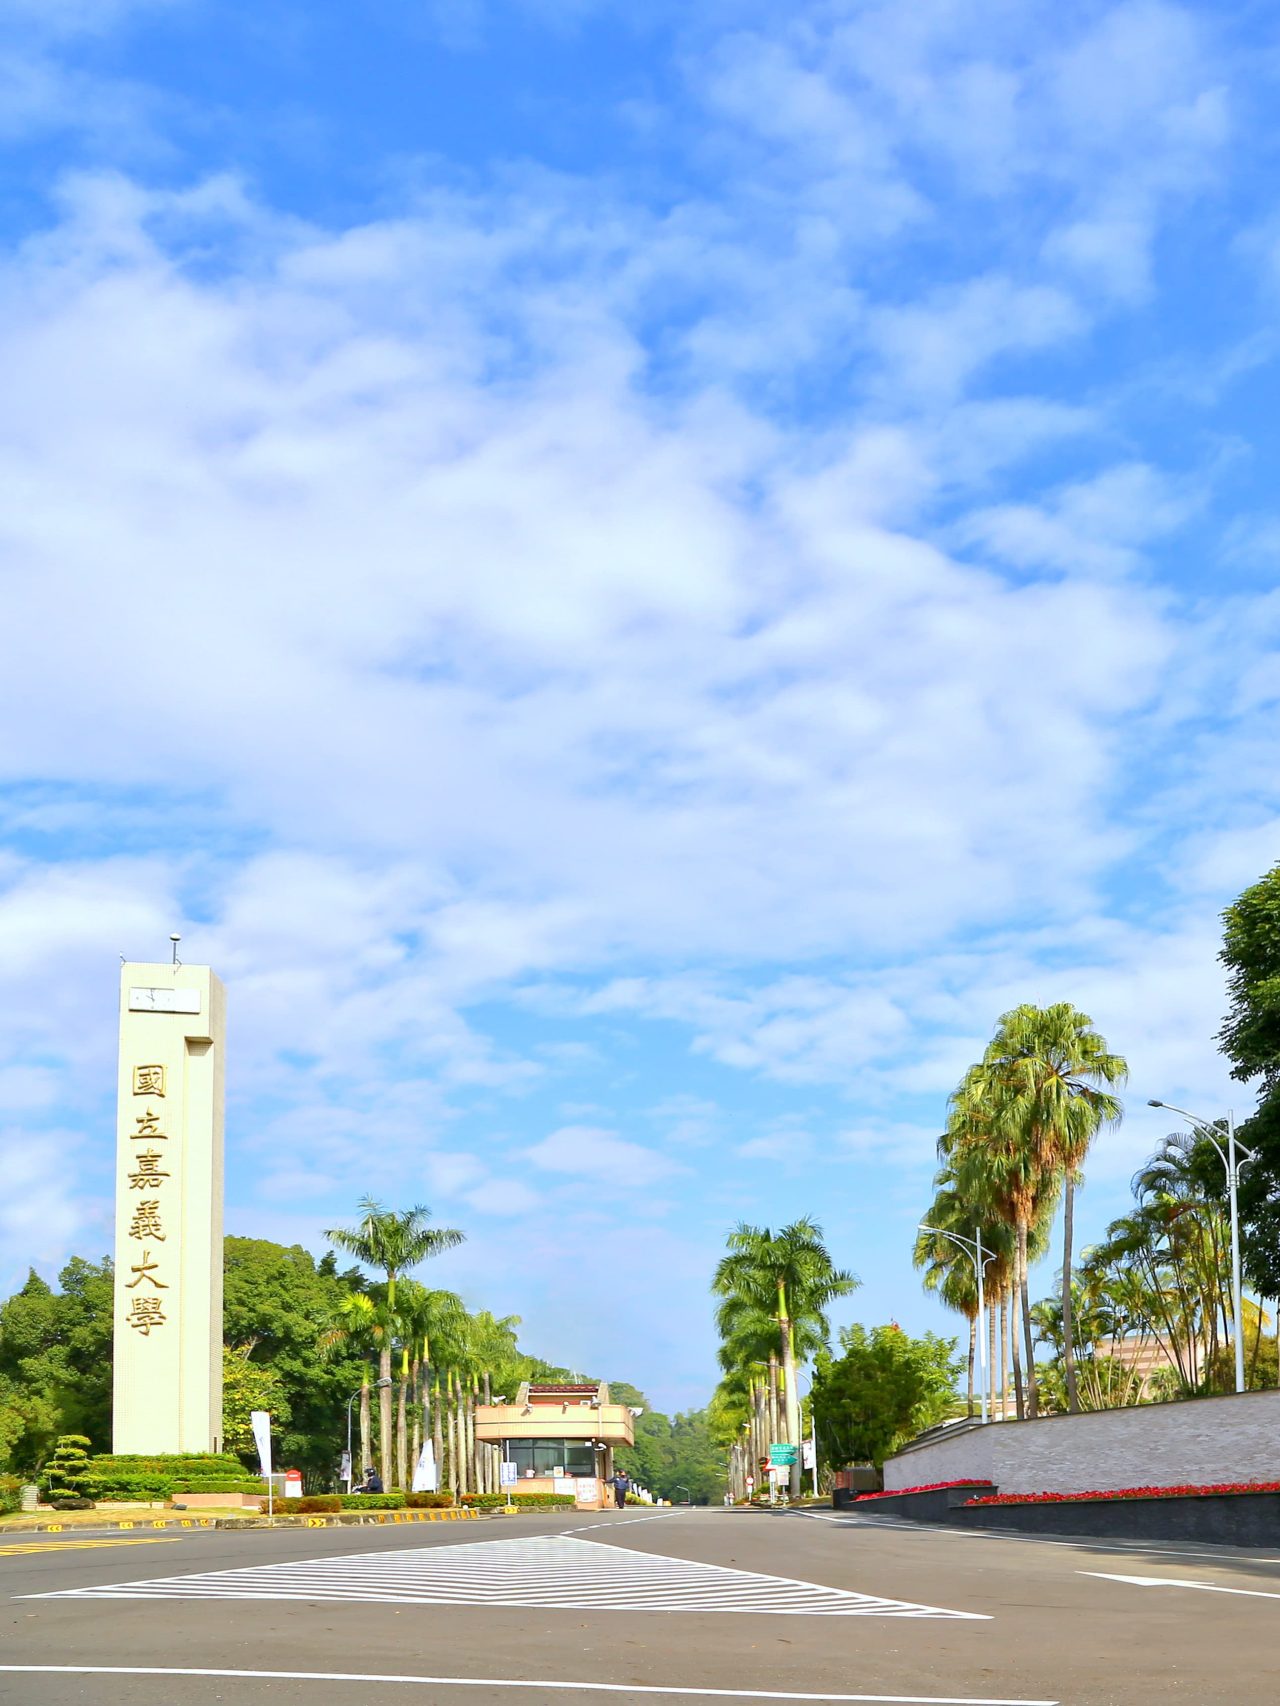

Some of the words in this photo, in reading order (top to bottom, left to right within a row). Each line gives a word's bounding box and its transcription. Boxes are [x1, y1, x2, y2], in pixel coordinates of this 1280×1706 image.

[125, 1064, 170, 1336] 國立嘉義大學
